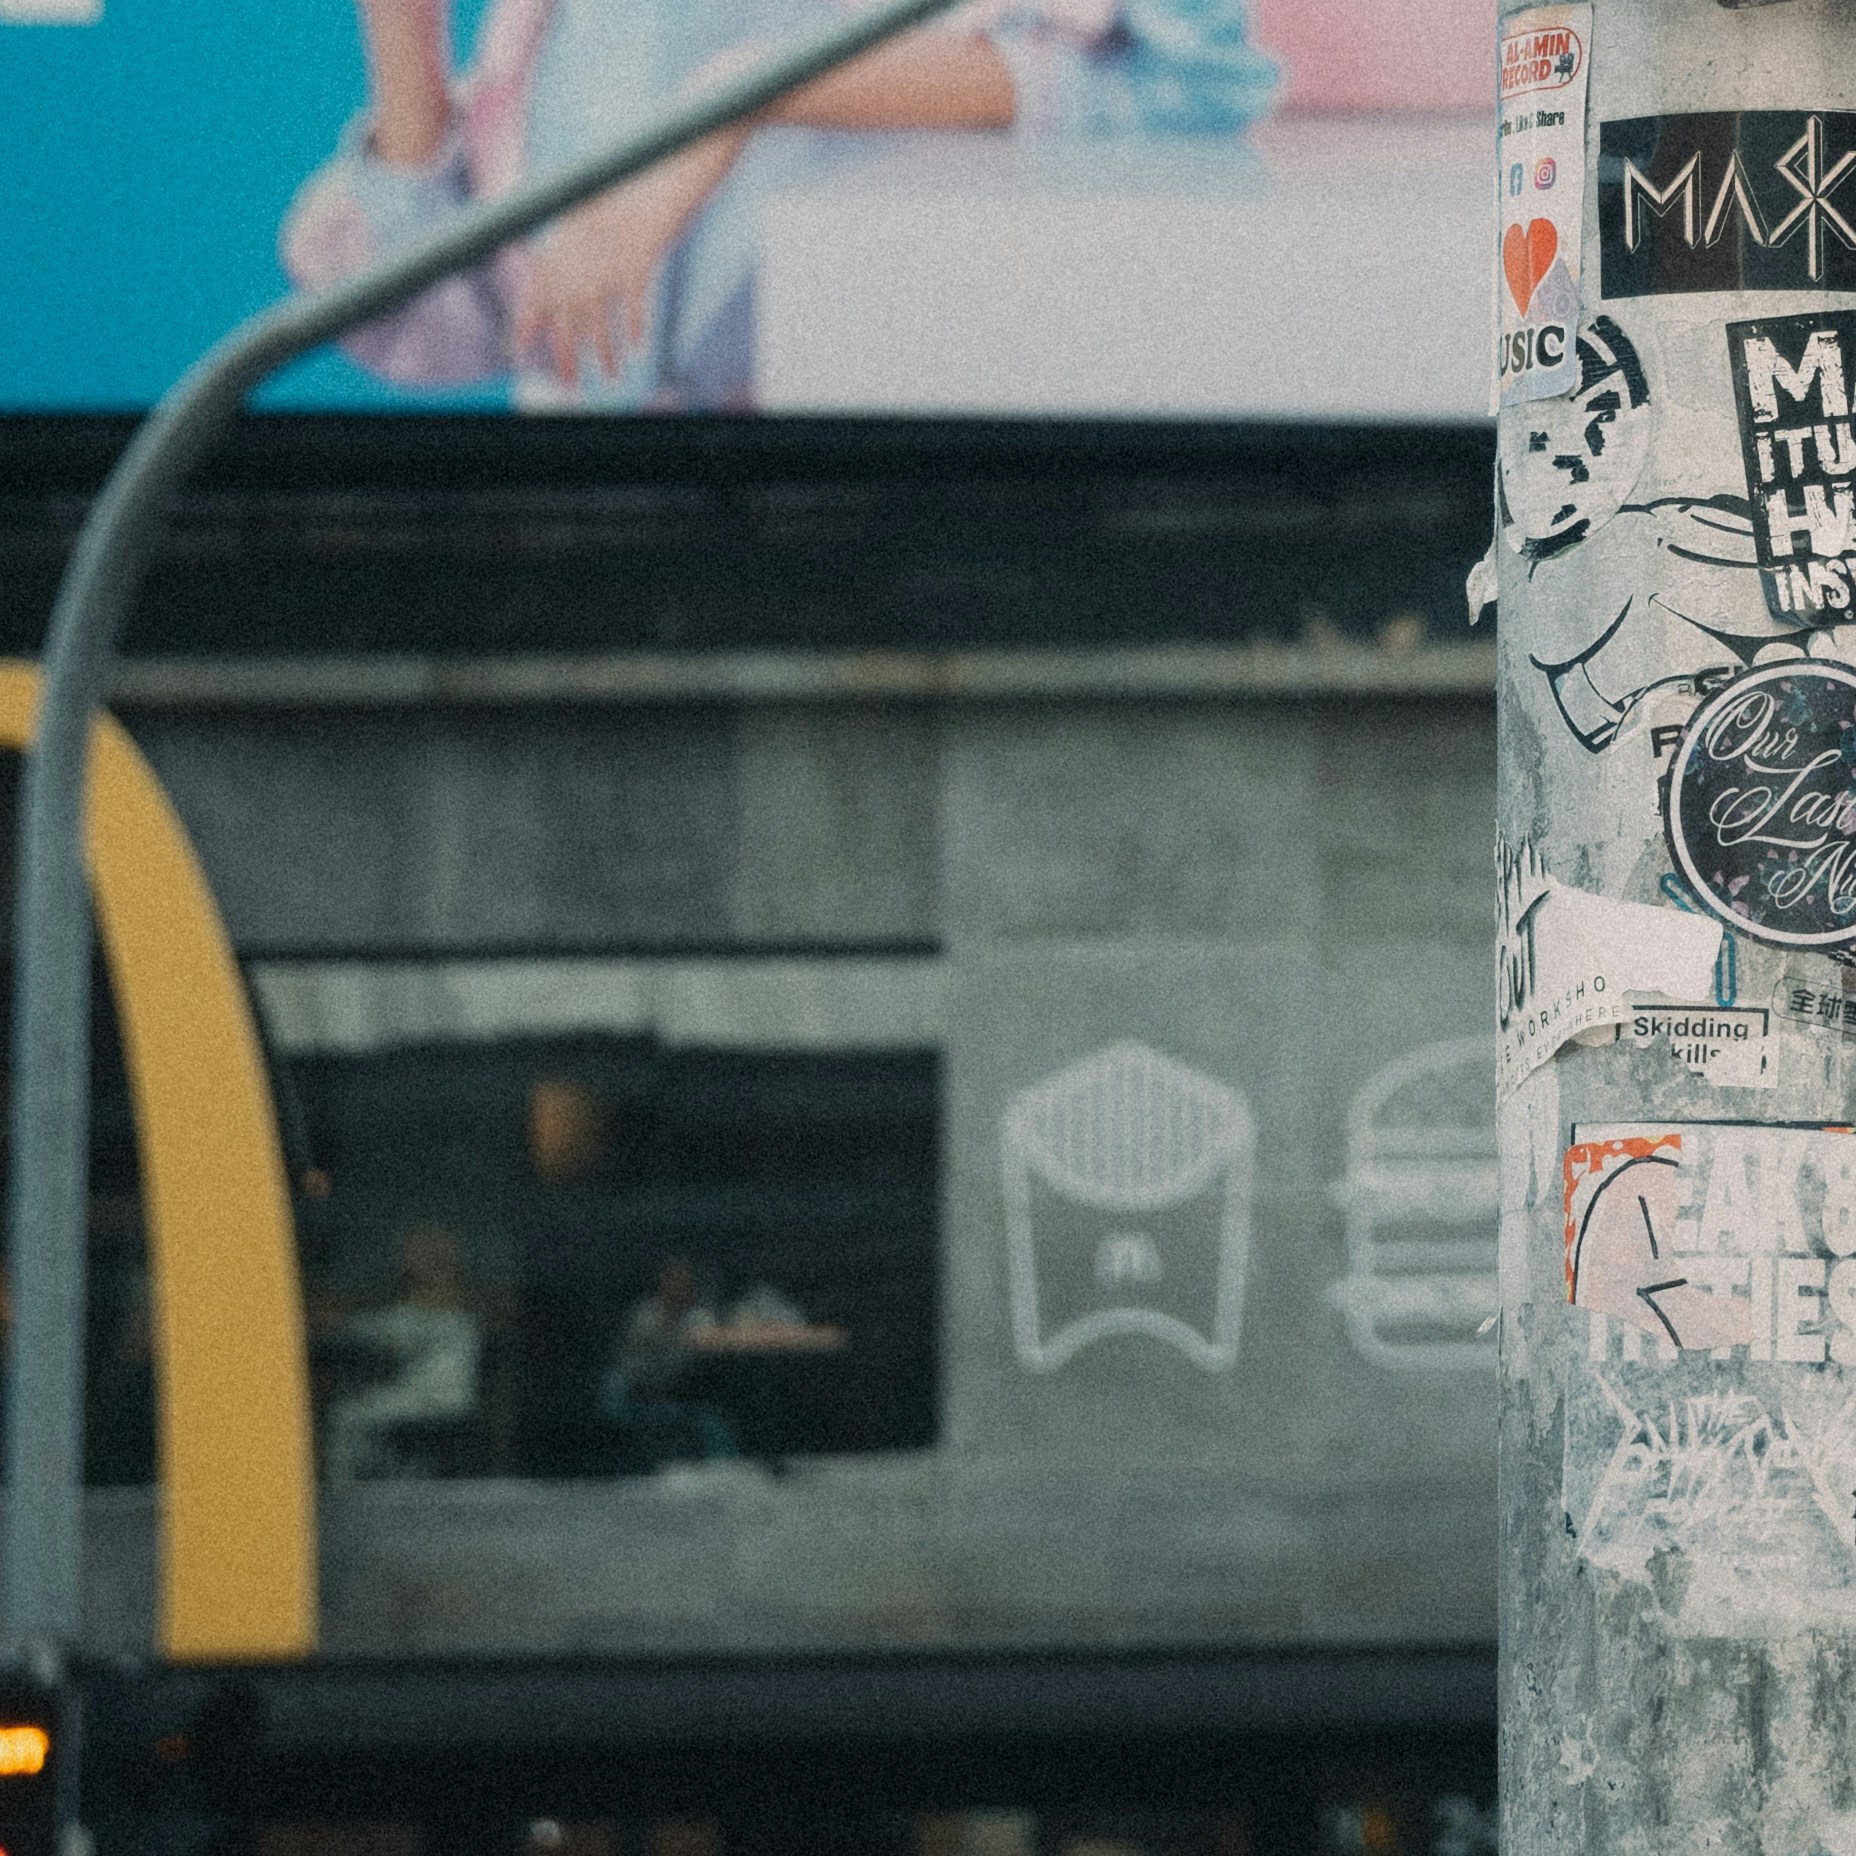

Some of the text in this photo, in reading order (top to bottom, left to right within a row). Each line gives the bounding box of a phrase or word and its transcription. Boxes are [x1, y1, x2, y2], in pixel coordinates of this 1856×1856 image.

[1502, 59, 1553, 91] RECORD
[1536, 109, 1566, 128] Share
[1499, 325, 1566, 377] USIC
[1704, 690, 1799, 762] Our
[1633, 1016, 1750, 1041] Skidding
